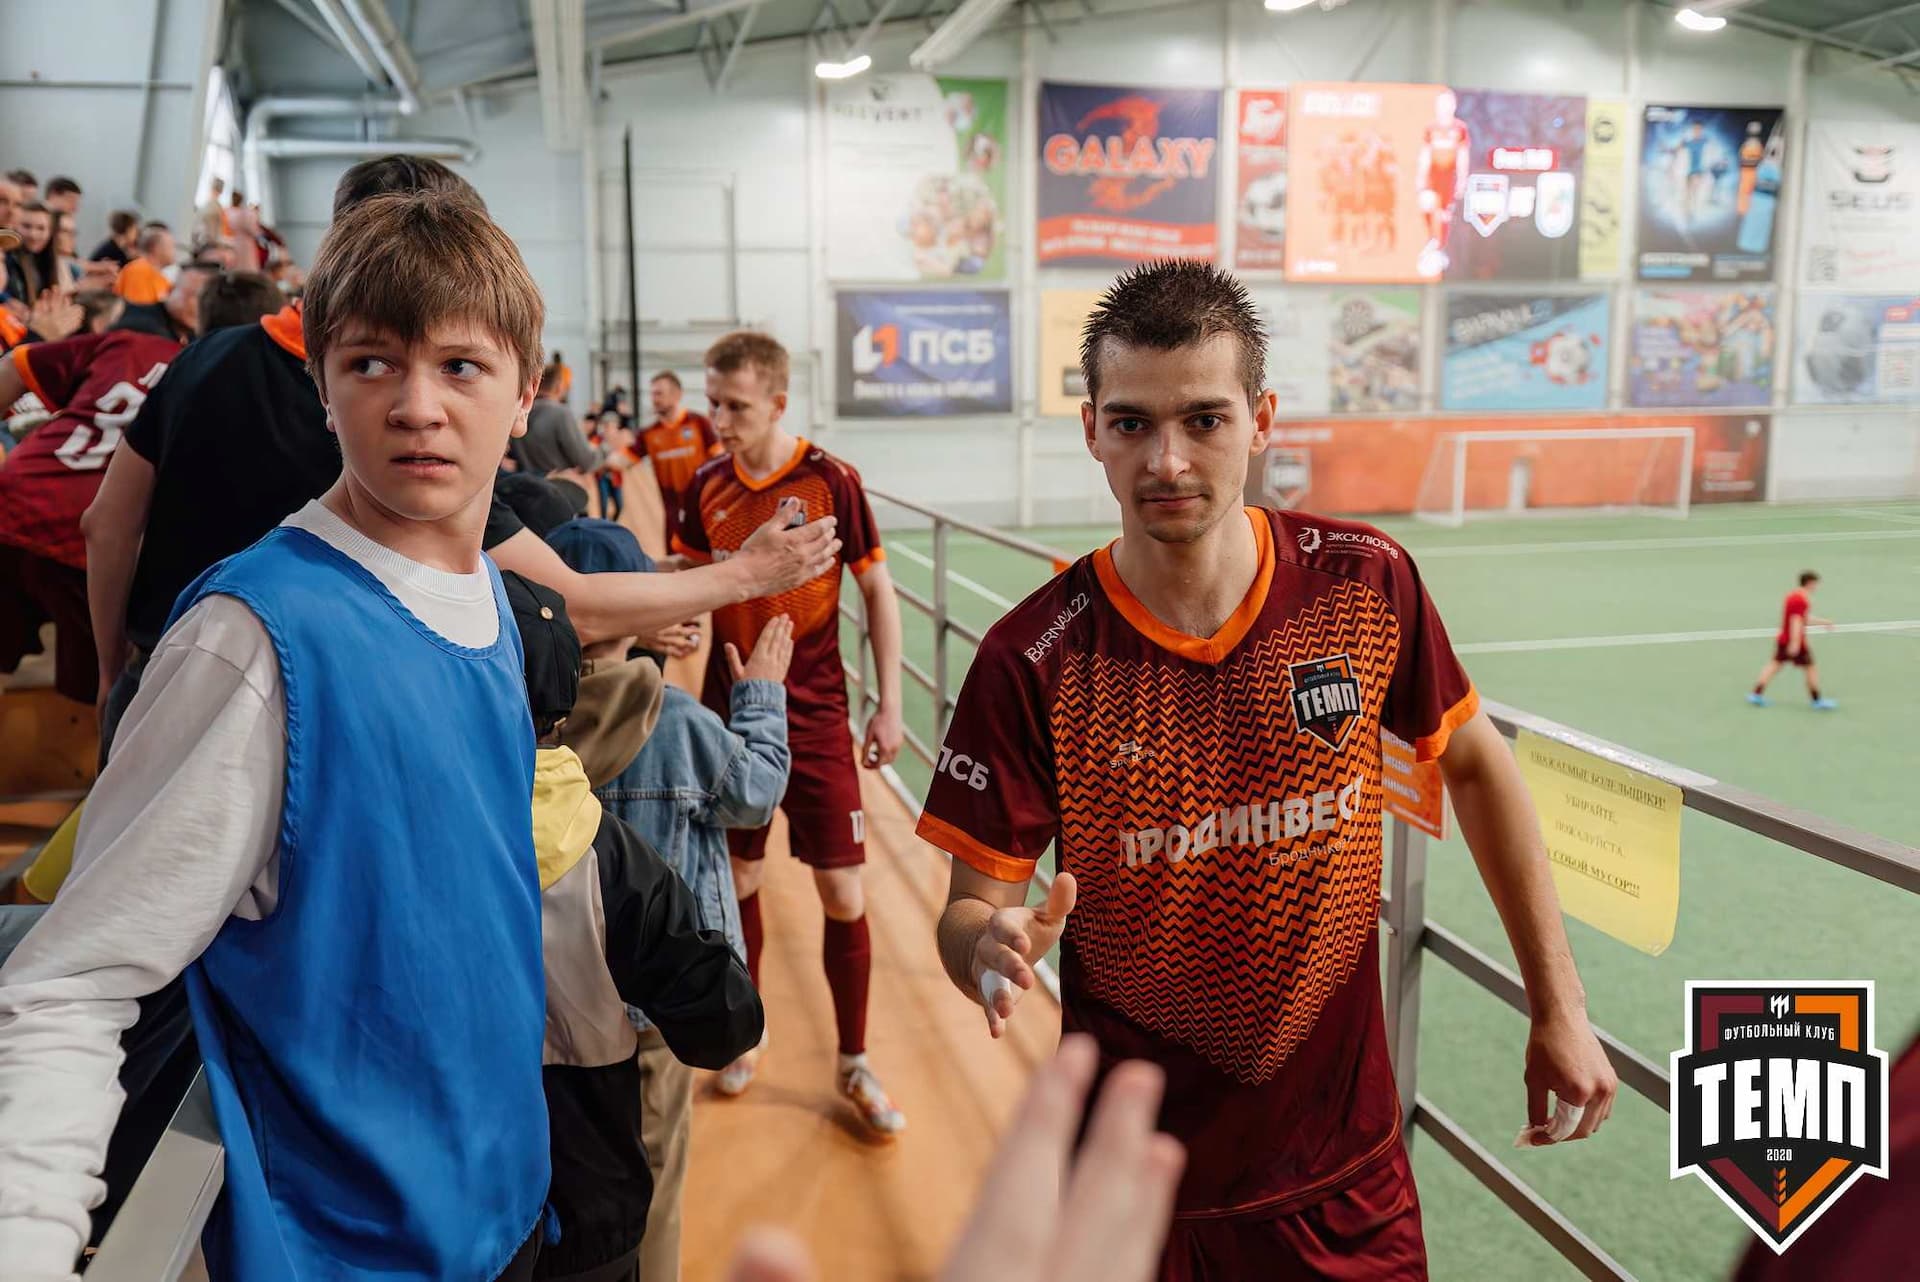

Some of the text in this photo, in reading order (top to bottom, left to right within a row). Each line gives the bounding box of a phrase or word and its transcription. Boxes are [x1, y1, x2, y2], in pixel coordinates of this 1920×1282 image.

[1043, 133, 1216, 178] GALAXY
[908, 328, 995, 365] ПСБ
[1326, 532, 1399, 559] ЭКСКЛЮЗИВ
[1297, 683, 1358, 721] ТЕМП
